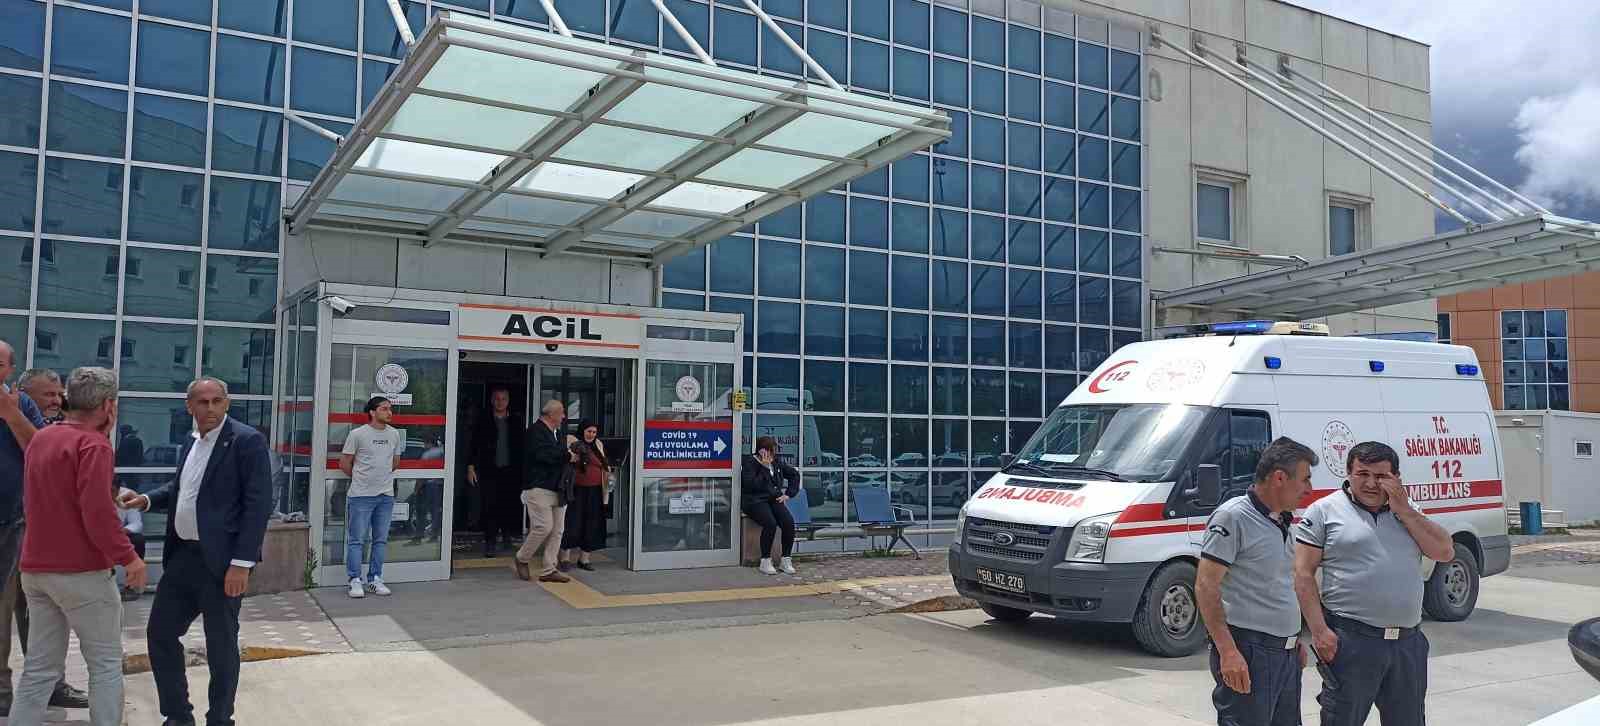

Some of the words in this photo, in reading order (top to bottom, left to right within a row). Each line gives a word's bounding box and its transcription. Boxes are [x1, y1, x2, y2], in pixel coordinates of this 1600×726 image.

[1105, 370, 1131, 382] 112
[1432, 416, 1449, 434] T.C.
[687, 431, 697, 439] 19
[649, 441, 664, 450] AŞI
[664, 441, 709, 449] UYGULAMA
[1405, 435, 1438, 457] SAĞLIK
[1438, 434, 1482, 456] BAKANLIĞI
[1431, 460, 1463, 479] 112
[981, 569, 992, 582] 60
[995, 573, 1006, 585] HZ
[1007, 575, 1024, 589] 270
